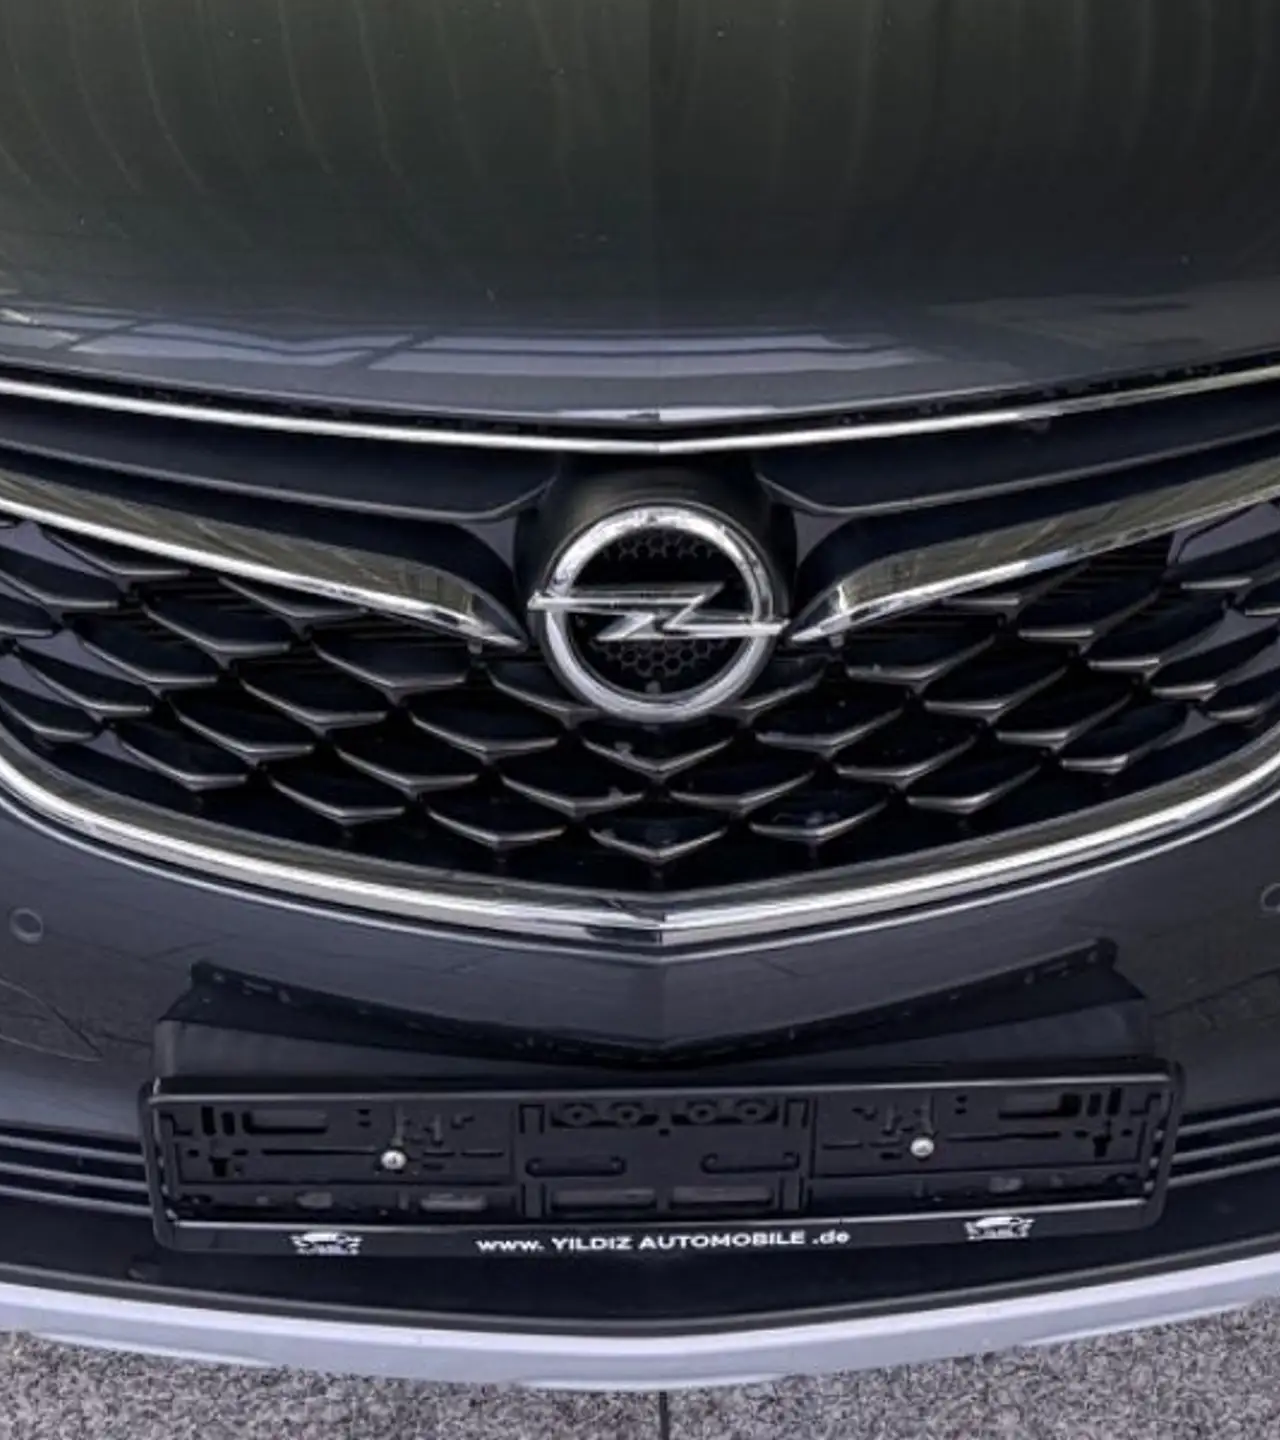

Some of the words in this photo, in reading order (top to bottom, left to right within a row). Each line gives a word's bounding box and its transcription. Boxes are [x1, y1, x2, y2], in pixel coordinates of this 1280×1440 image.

[475, 1239, 545, 1252] www.
[551, 1235, 633, 1251] YILDIZ
[637, 1229, 806, 1250] AUTOMOBILE
[811, 1229, 851, 1245] .de
